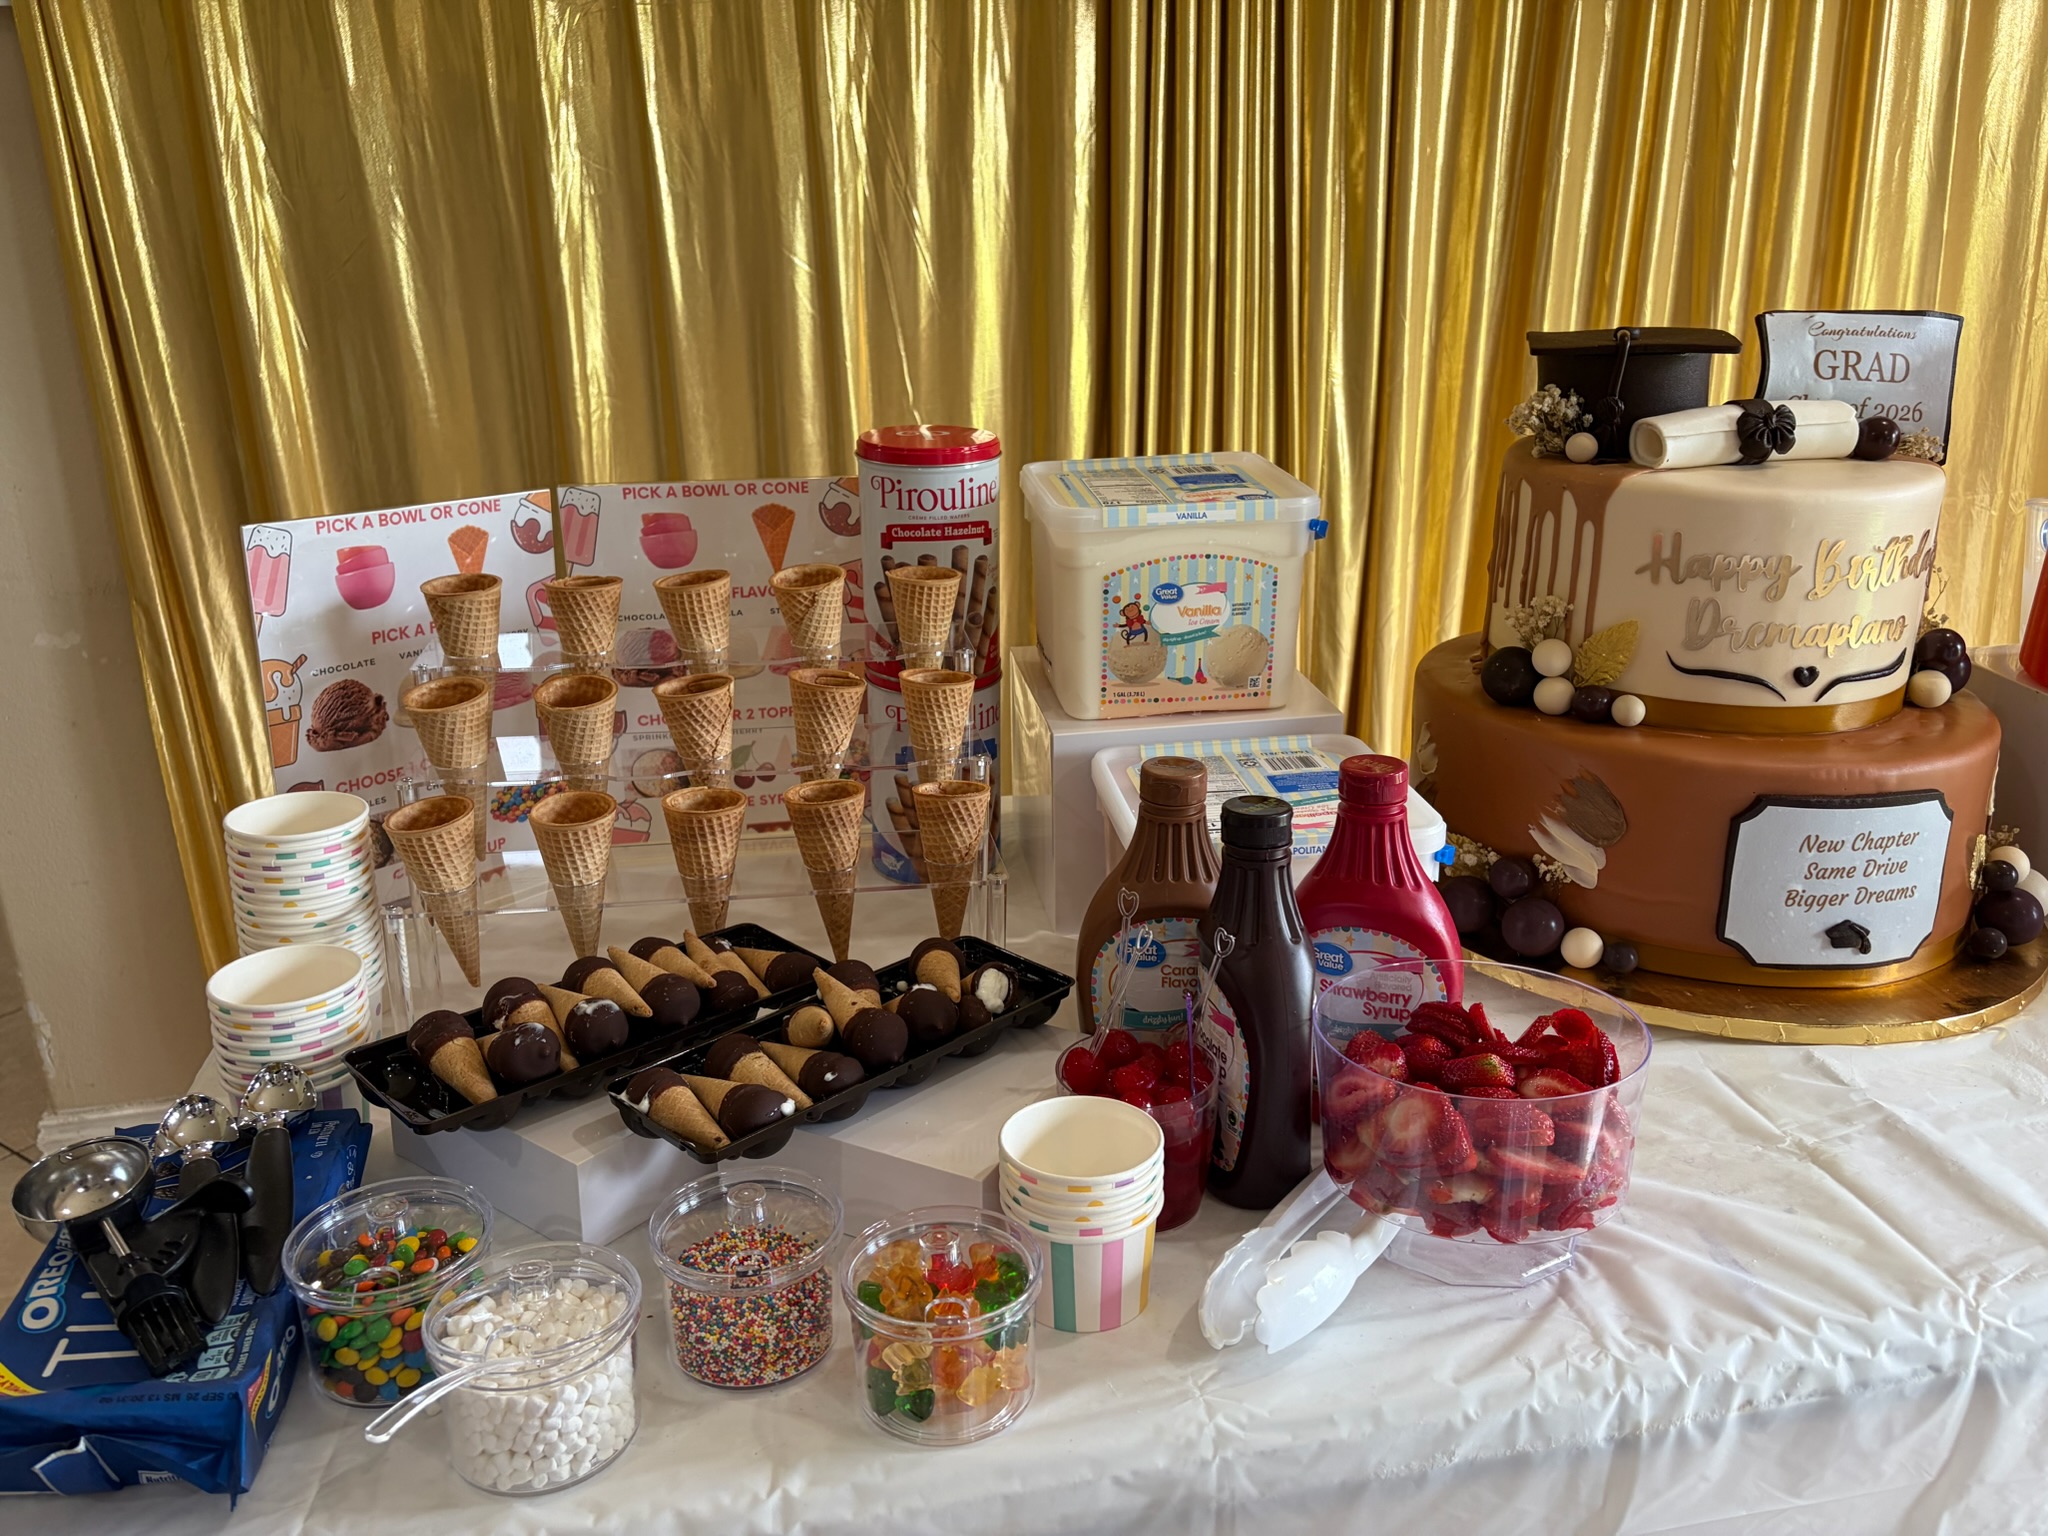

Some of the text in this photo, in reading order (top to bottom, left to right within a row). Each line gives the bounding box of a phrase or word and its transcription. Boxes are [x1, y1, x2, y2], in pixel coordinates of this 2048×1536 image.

[1808, 321, 1917, 341] Congratulations
[1813, 349, 1910, 384] GRAD
[1873, 401, 1923, 422] 2026
[622, 481, 809, 500] PICK A BOWL OR CONE
[870, 475, 997, 512] Pirouline
[315, 498, 502, 535] PICK A BOWL OR CONE
[1176, 511, 1208, 521] VANILLA
[891, 527, 942, 538] Chocolate
[944, 524, 985, 537] Hazelnut
[1634, 529, 1803, 602] Happy
[732, 586, 775, 599] FLAVO
[1155, 587, 1178, 596] Great
[617, 613, 666, 623] CHOCOLA
[1177, 604, 1222, 618] Vanilla
[371, 625, 411, 645] PICK
[414, 623, 425, 637] A
[312, 658, 376, 677] CHOCOLATE
[733, 709, 742, 720] R
[746, 708, 755, 720] 2
[758, 706, 794, 719] TOPP
[885, 703, 1000, 733] Pline
[1293, 845, 1327, 855] POLITAN
[1798, 829, 1920, 857] New Chapter
[1804, 857, 1908, 881] Same Drive
[1784, 883, 1917, 913] Bigger Dreams
[1138, 954, 1157, 962] alue
[1318, 960, 1344, 971] Value
[1161, 964, 1198, 976] Cara
[1161, 976, 1198, 988] Flavo
[1362, 1001, 1411, 1022] Syrup
[22, 1250, 73, 1330] OREO
[202, 1392, 224, 1402] SEP
